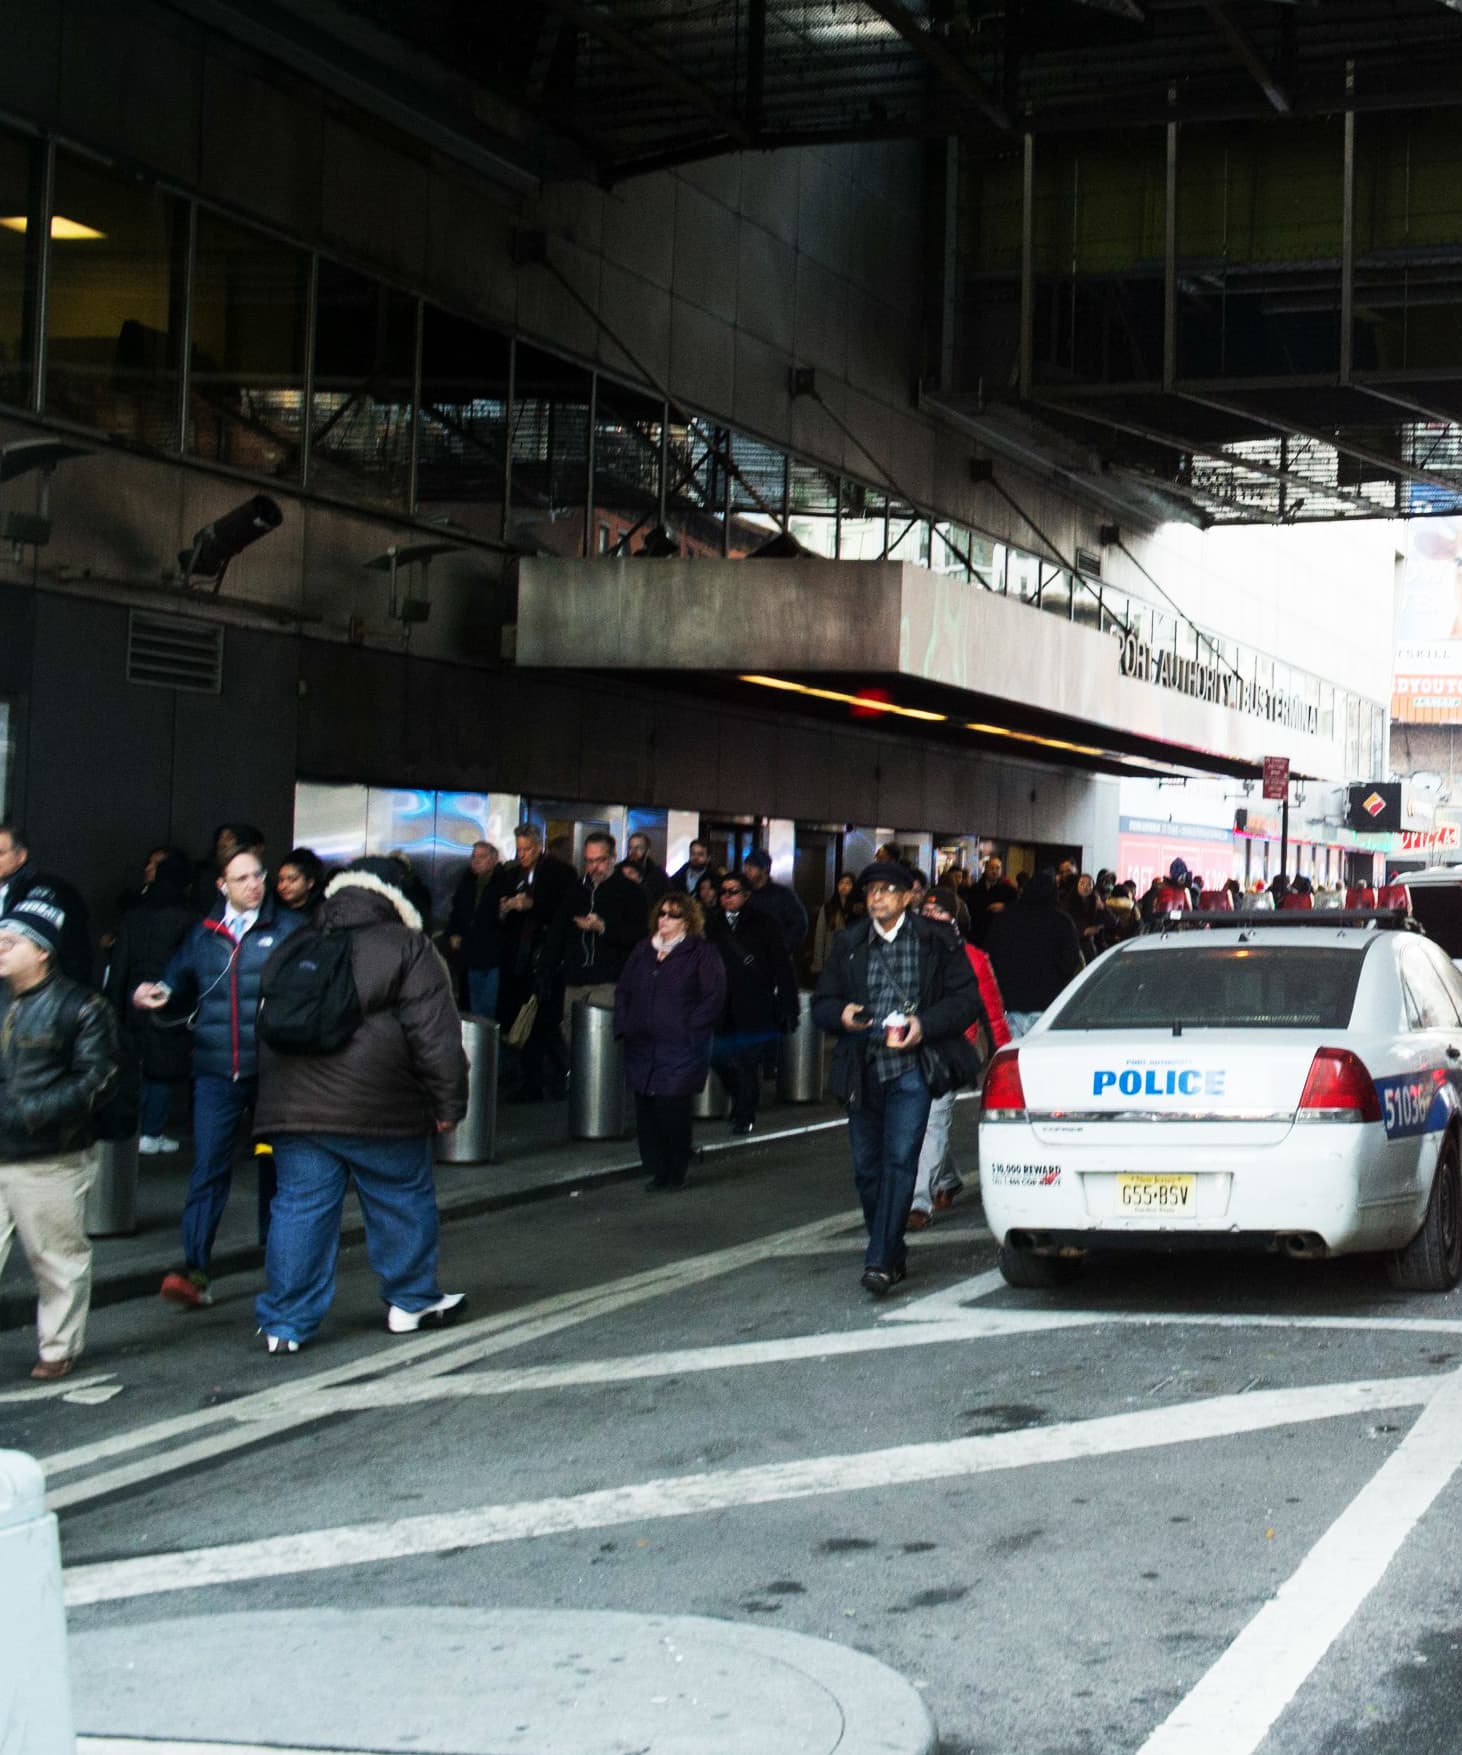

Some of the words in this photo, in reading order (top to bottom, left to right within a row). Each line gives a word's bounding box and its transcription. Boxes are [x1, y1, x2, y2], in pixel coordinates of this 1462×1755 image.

[1118, 633, 1152, 682] PORT
[1155, 649, 1232, 707] AUTHORITY
[1243, 680, 1263, 717] BUS
[1265, 689, 1319, 736] TERMINA
[1093, 1070, 1226, 1096] POLICE
[1383, 1082, 1428, 1131] 51036
[1023, 1164, 1061, 1175] REWARD
